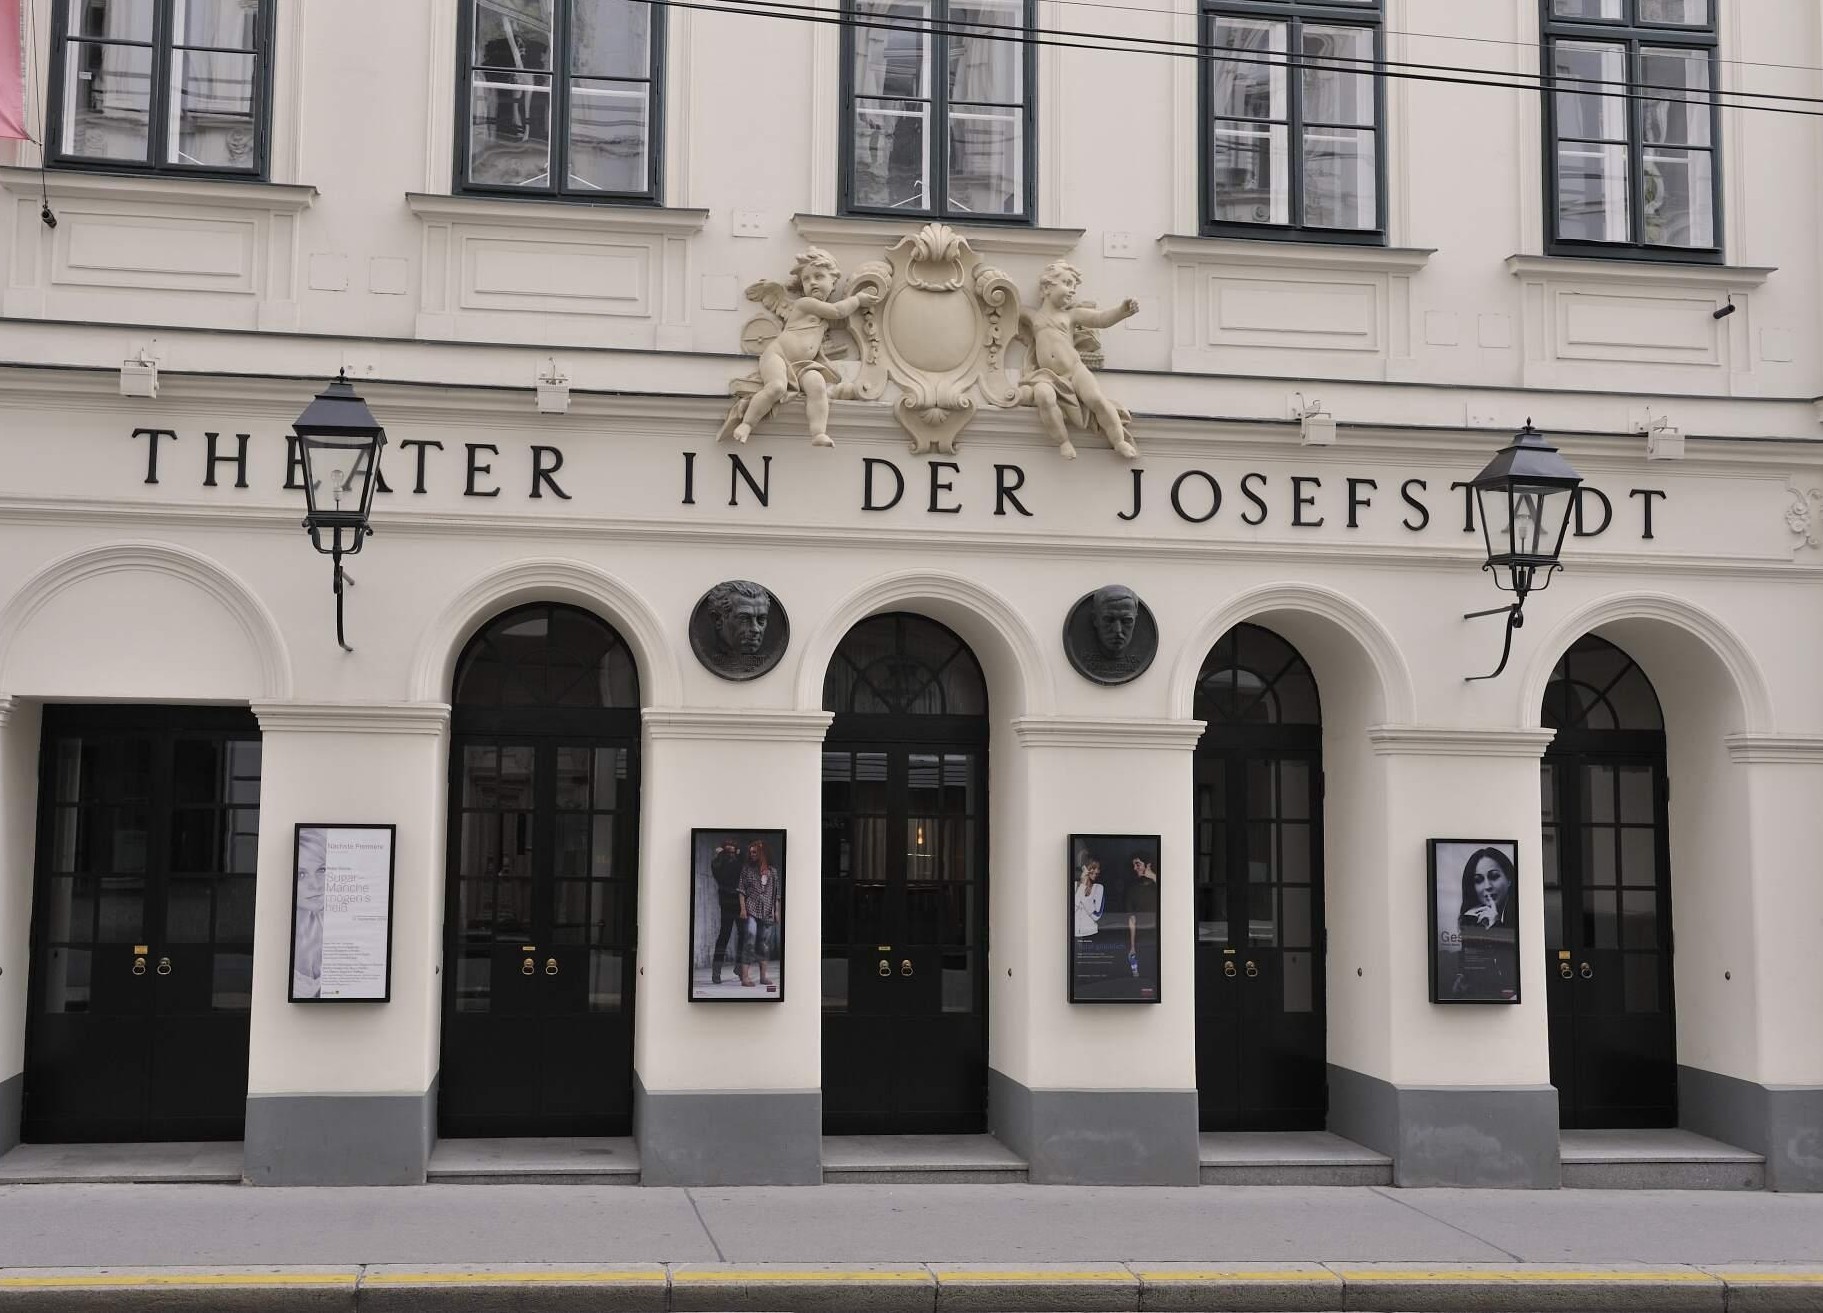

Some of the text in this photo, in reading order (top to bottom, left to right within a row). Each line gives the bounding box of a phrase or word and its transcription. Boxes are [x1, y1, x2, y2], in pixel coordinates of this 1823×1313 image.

[131, 428, 1667, 539] THEATER IN DER JOSEFSTADT
